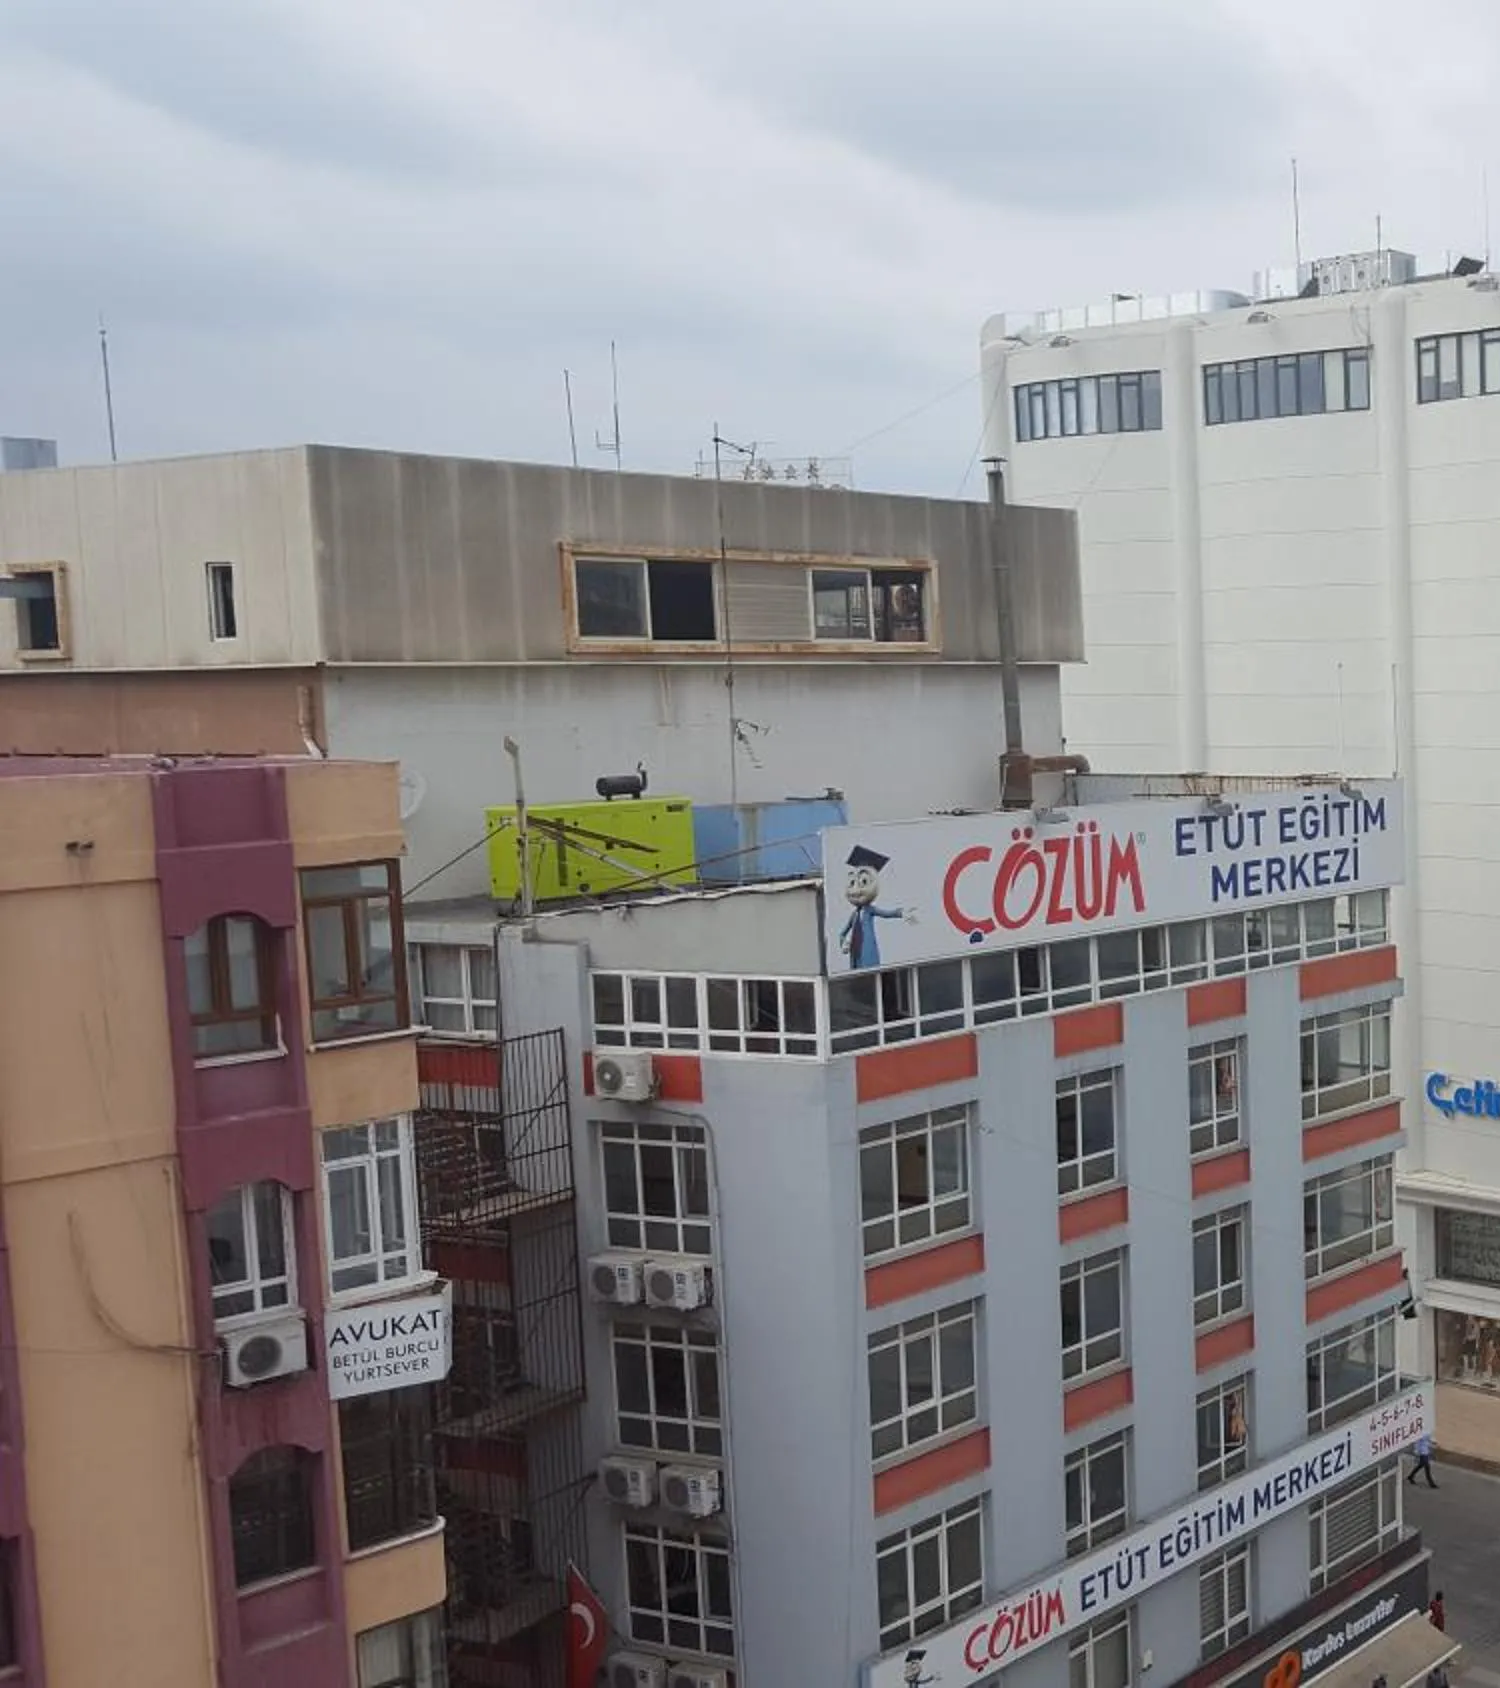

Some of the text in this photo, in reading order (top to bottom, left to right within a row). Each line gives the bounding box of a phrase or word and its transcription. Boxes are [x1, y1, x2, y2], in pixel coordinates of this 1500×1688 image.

[1175, 793, 1387, 857] ETÜT EĞİTİM
[943, 821, 1145, 944] ÇÖZÜM
[1211, 837, 1359, 902] MERKEZİ
[329, 1309, 442, 1348] AVUKAT
[333, 1339, 440, 1369] BETÜL BURCU
[344, 1358, 430, 1383] YURTSEVER
[1371, 1417, 1424, 1457] SINIFLAR
[964, 1431, 1352, 1673] ÇÖZÜM ETÜT EĞİTİM MERKEZİ
